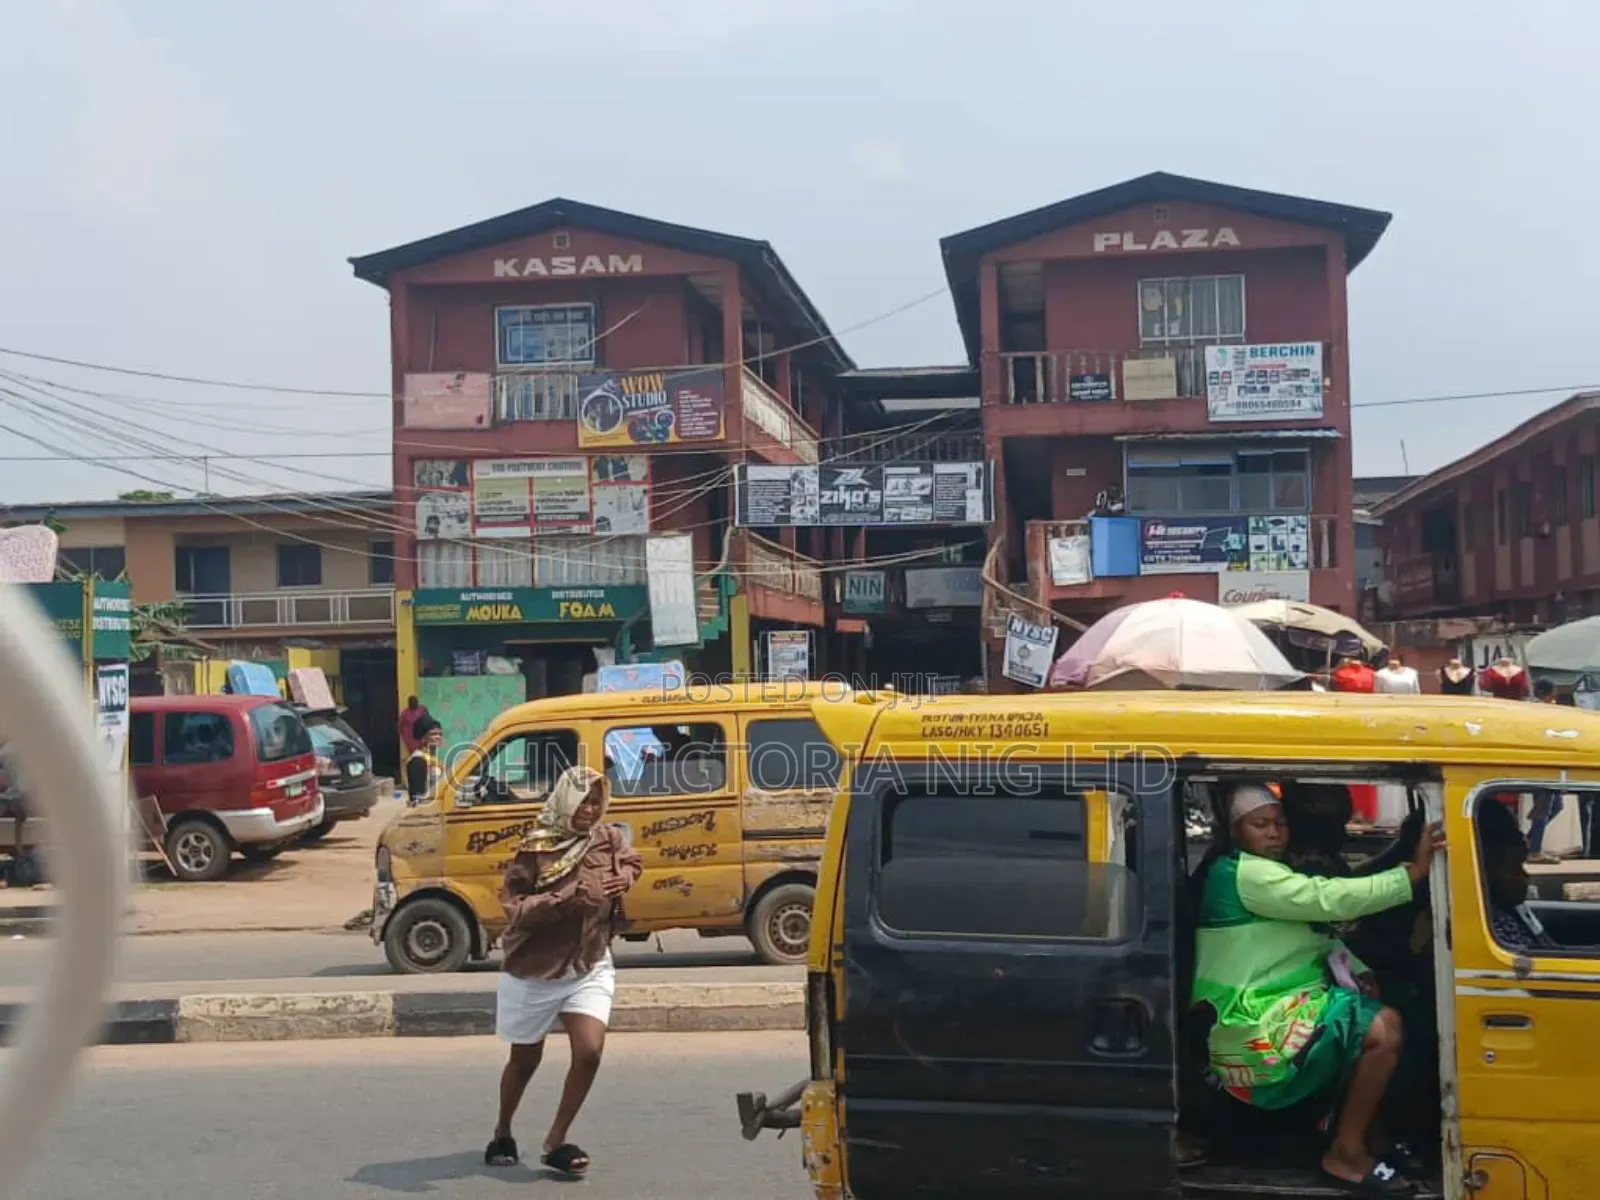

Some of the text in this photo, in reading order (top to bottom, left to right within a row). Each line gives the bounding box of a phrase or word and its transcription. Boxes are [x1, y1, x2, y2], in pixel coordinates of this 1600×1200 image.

[1093, 227, 1241, 252] PLAZA
[493, 254, 645, 277] KASAM
[1249, 345, 1316, 358] BERCHIN
[621, 373, 666, 393] WOW
[621, 390, 668, 408] STUDIO
[850, 578, 882, 595] NIN
[465, 603, 523, 621] MOUKA
[558, 601, 616, 618] FOAM
[1009, 618, 1054, 644] NYSC
[99, 675, 126, 707] NYSC
